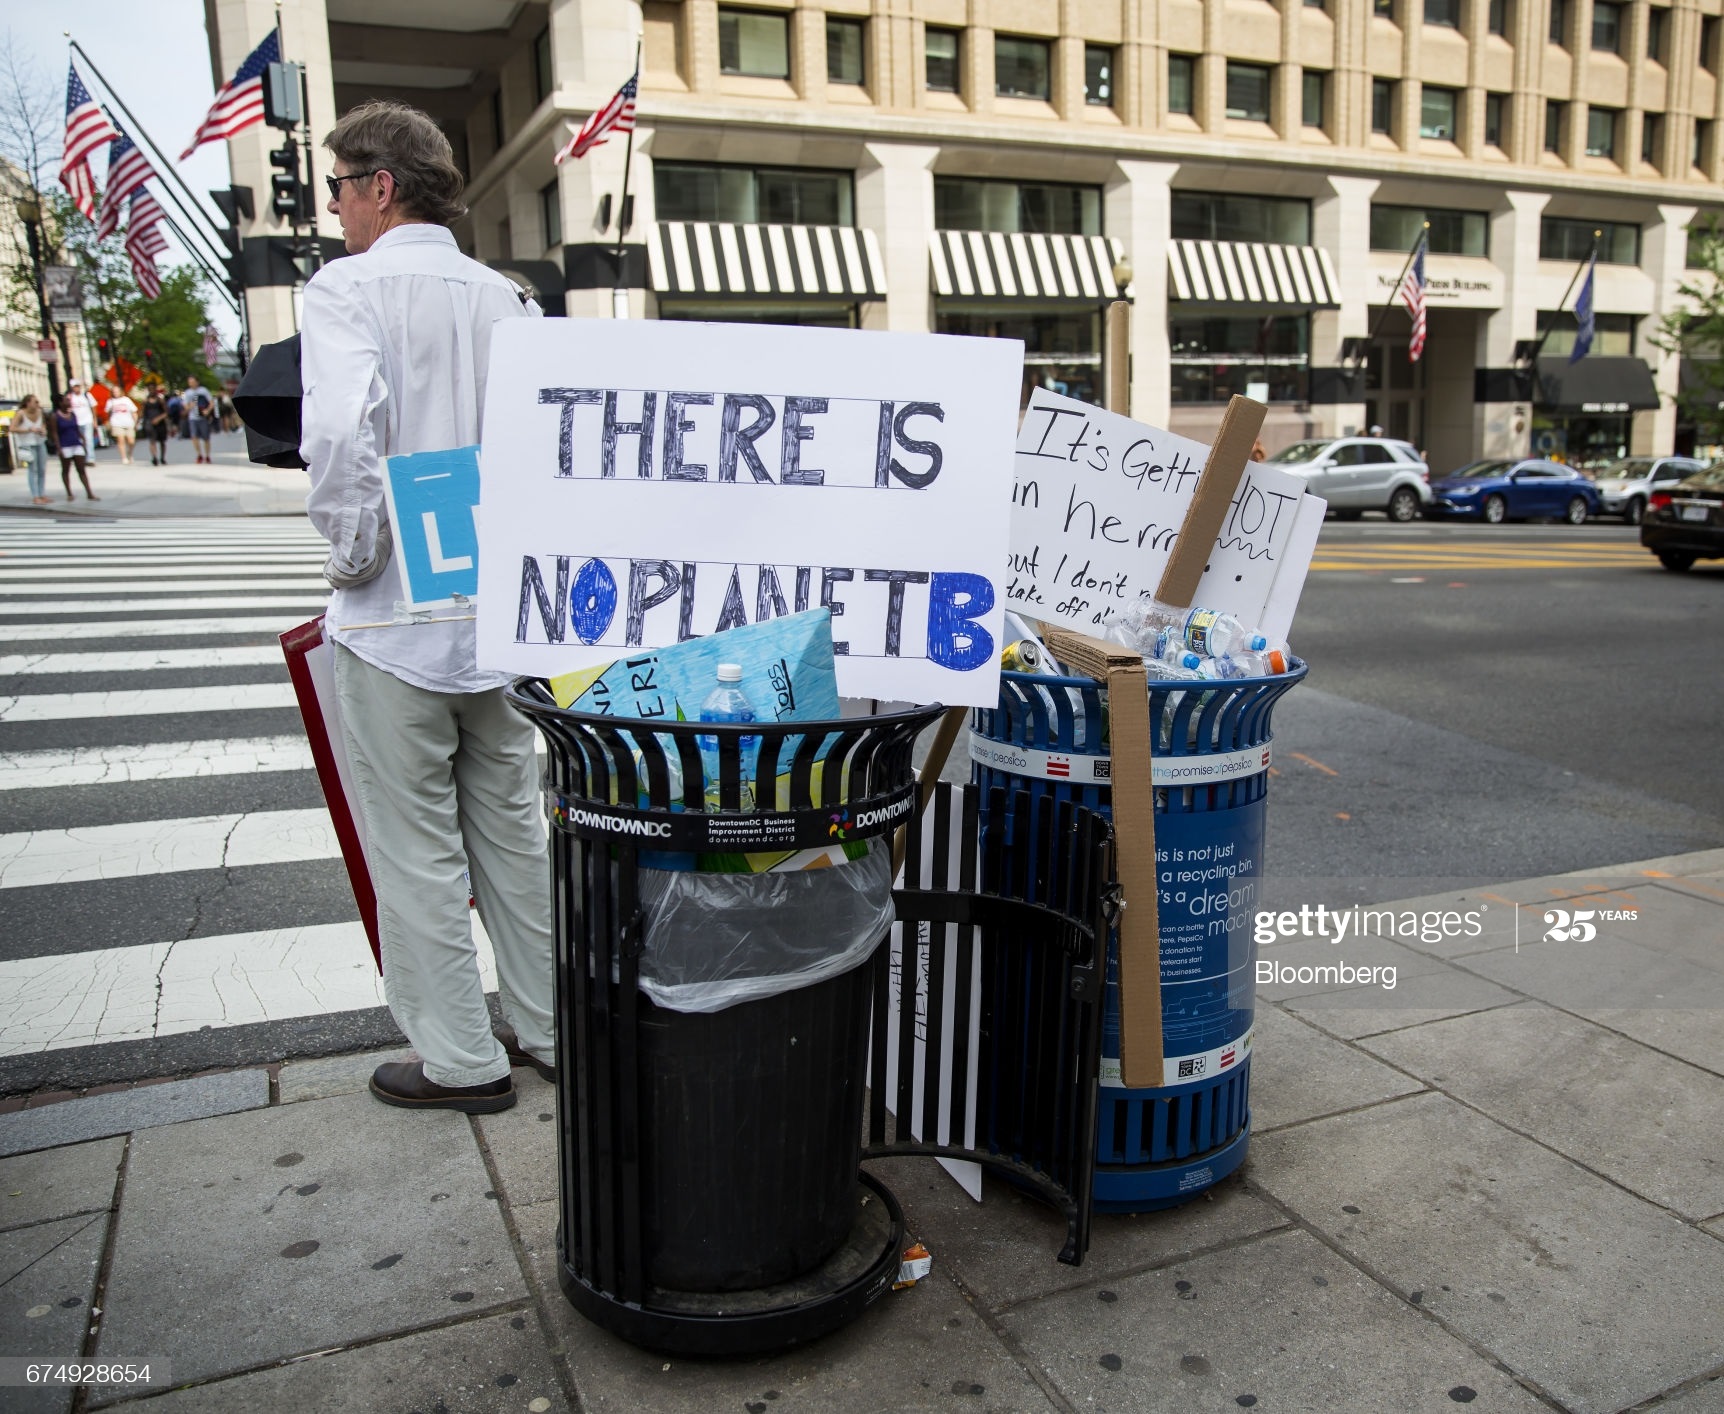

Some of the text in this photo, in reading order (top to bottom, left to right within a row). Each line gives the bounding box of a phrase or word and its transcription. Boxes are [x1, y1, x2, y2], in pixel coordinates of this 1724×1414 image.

[538, 387, 945, 490] THERE IS
[1016, 405, 1200, 494] It's Getti
[1011, 476, 1040, 509] in
[1070, 560, 1128, 598] don't
[1006, 577, 1046, 606] take
[1055, 596, 1090, 618] off
[626, 656, 666, 719] ER!
[768, 663, 793, 722] JOBS
[569, 807, 672, 838] DOWNTOWNDC
[708, 818, 796, 827] DowntownDC Business
[708, 826, 796, 836] Improvement District
[708, 835, 796, 843] downtowndc.org
[1173, 848, 1184, 862] is
[1188, 846, 1212, 861] not
[1214, 842, 1235, 862] just
[1161, 871, 1172, 883] a
[1177, 865, 1236, 884] recycling
[1175, 891, 1187, 903] a
[1189, 883, 1254, 916] dream
[1177, 934, 1204, 944] PepsiCo
[1186, 923, 1205, 931] bottle
[1160, 955, 1203, 966] veterans start
[1165, 946, 1196, 955] donation
